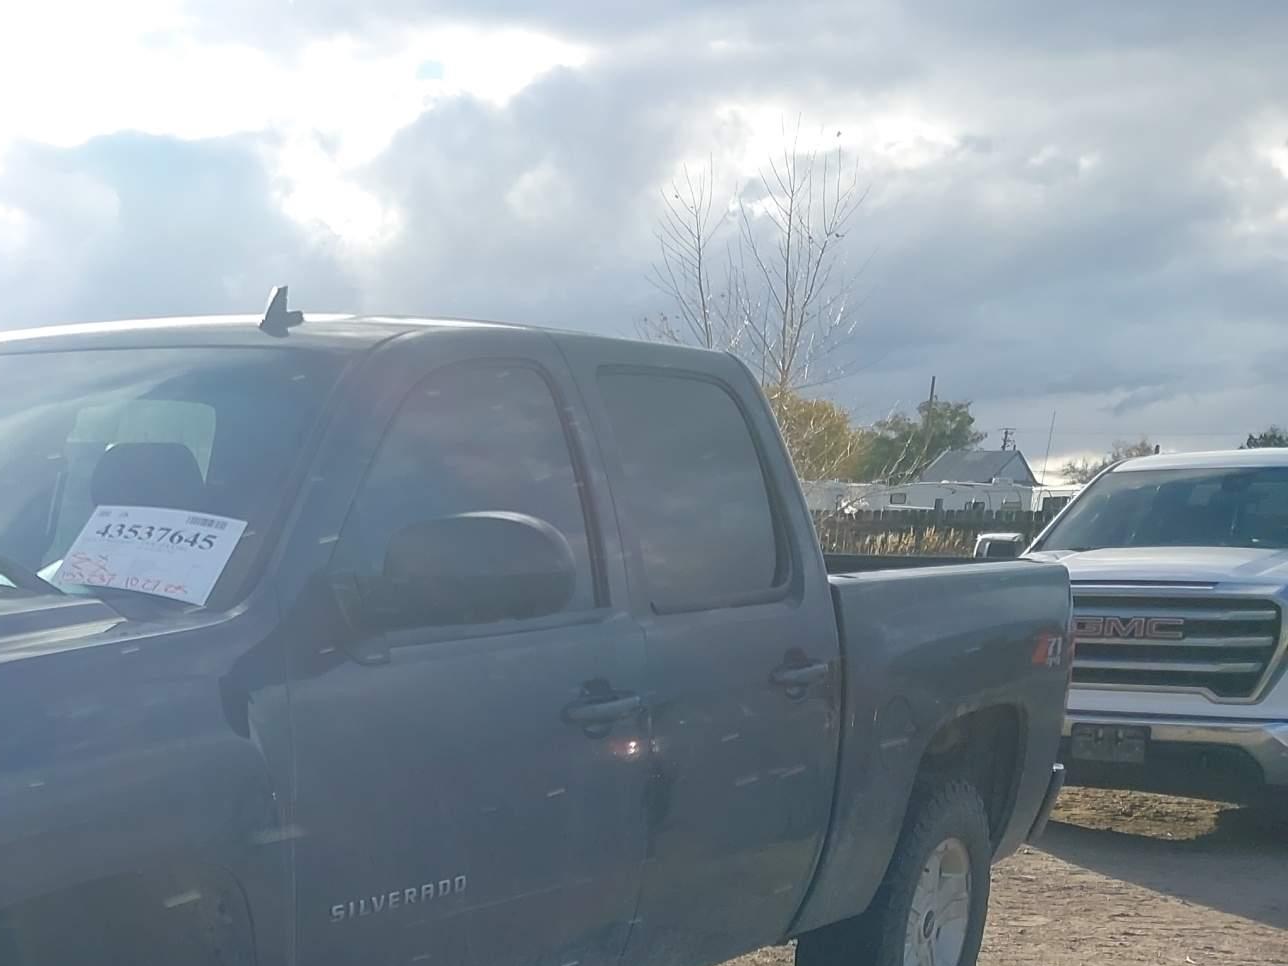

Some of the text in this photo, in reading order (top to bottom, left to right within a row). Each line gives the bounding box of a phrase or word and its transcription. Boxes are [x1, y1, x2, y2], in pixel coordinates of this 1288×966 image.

[95, 523, 218, 550] 43537645
[1072, 616, 1185, 639] GMC
[328, 874, 468, 923] SILVERADO
